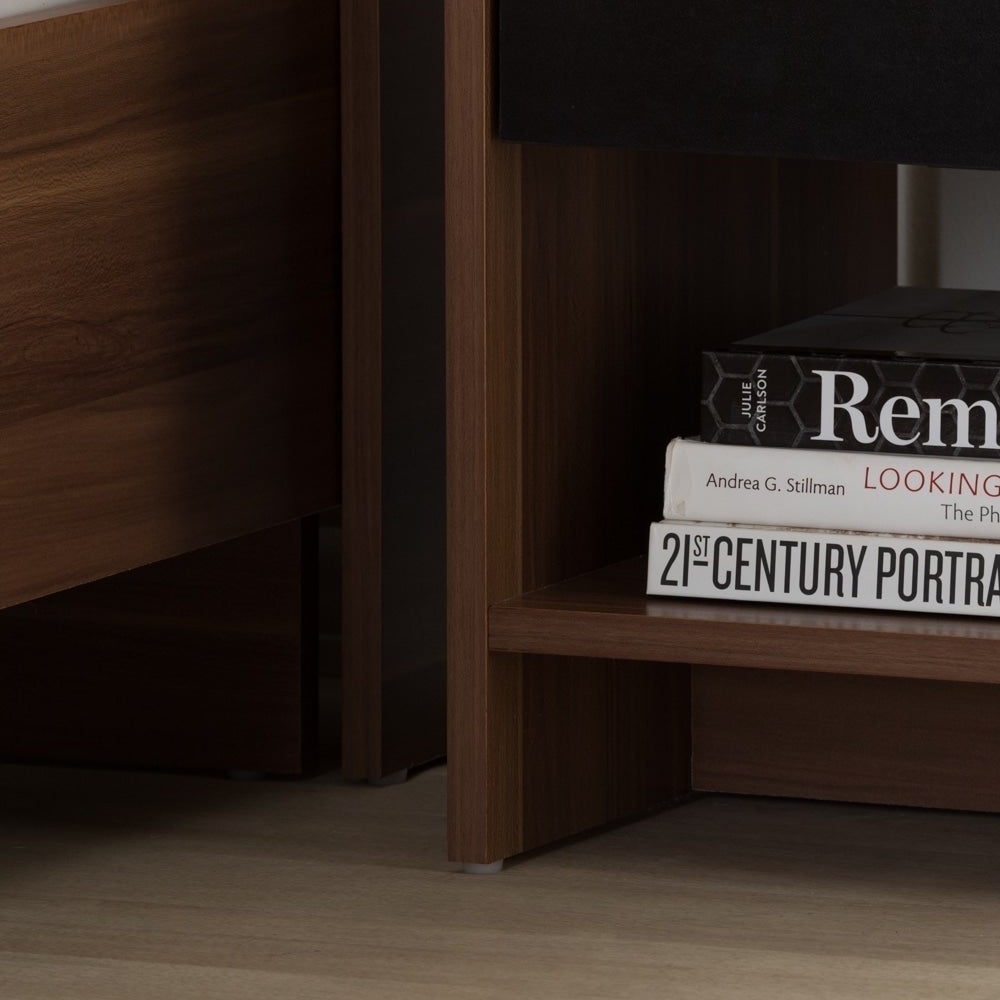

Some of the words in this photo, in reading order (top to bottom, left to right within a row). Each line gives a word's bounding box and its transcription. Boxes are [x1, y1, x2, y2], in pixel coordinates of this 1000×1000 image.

[740, 381, 752, 418] JULIE
[755, 368, 768, 433] CARLSON
[705, 472, 760, 491] Andrea
[765, 476, 782, 492] G.
[787, 476, 846, 496] Stillman
[941, 503, 974, 522] The
[712, 535, 868, 599] CENTURY
